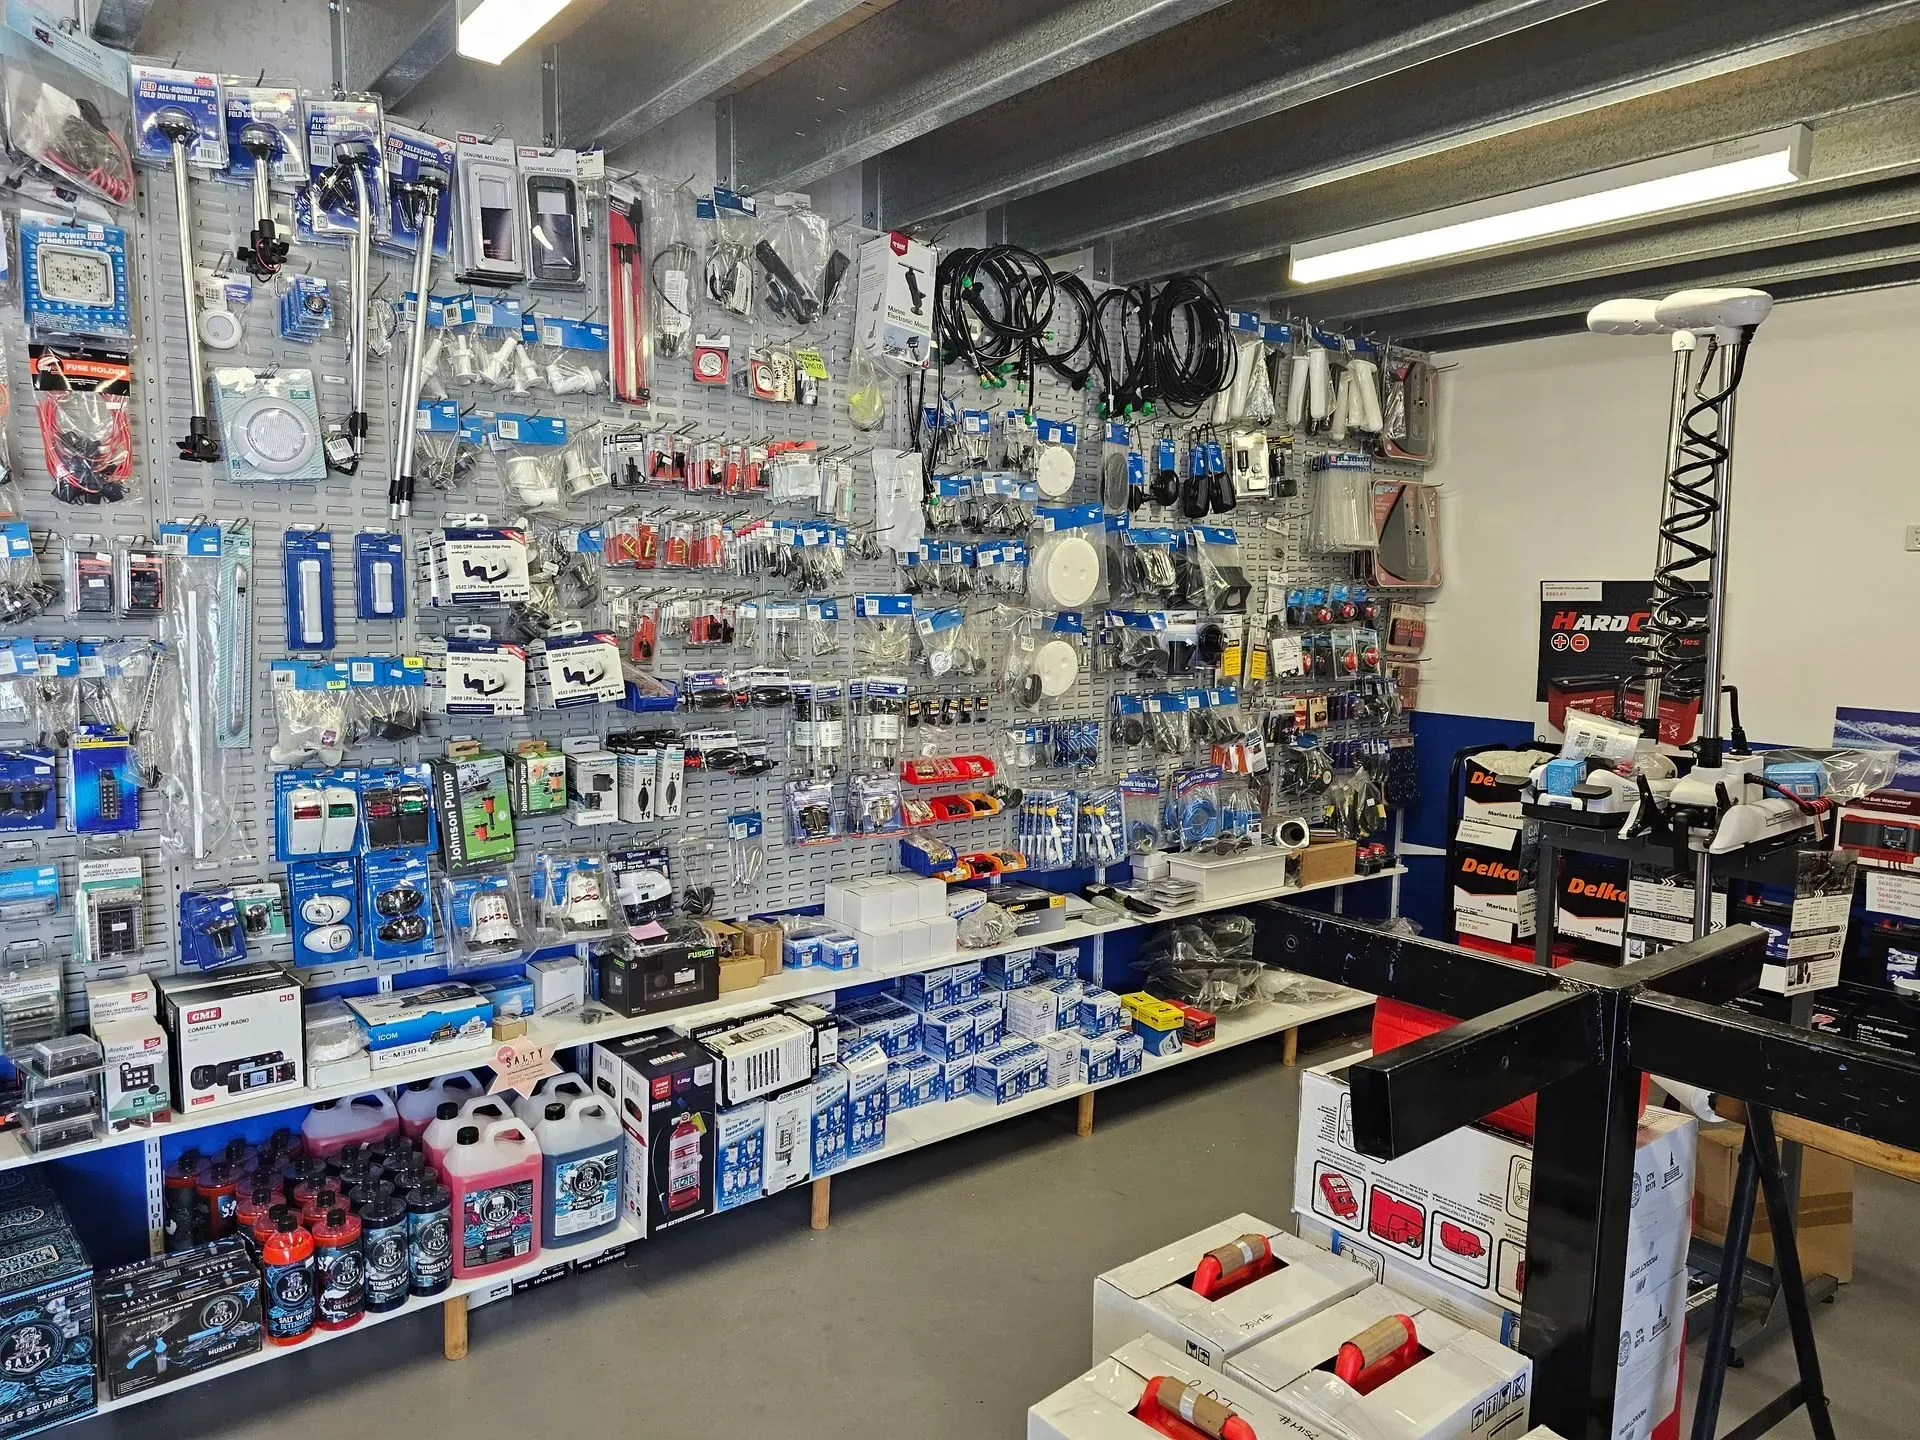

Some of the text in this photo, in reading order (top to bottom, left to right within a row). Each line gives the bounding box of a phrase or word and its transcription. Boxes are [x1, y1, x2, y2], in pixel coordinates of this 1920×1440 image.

[141, 82, 215, 96] LED ALL-ROUND LIGHTS
[177, 94, 200, 103] MOUNT
[389, 138, 438, 158] LED TELESCOPIC
[888, 305, 906, 315] Marine
[888, 312, 930, 330] Electronic Mount
[90, 366, 127, 376] HOLDER
[1625, 636, 1649, 644] AGM
[520, 784, 528, 812] Johnson
[443, 772, 462, 860] Johnson Pump
[1487, 810, 1507, 818] Marine
[1462, 858, 1519, 882] Delko
[1486, 902, 1508, 912] Marine
[1595, 926, 1619, 936] Marine
[688, 949, 715, 959] FUSION
[191, 1010, 217, 1021] GME
[188, 1024, 216, 1034] COMPACT
[231, 1018, 250, 1026] RADIO
[1857, 1024, 1908, 1038] Cyclic Applications:
[378, 1032, 398, 1041] ICOM
[506, 1047, 543, 1068] SALTY
[780, 1086, 811, 1100] 320R-RAC-01
[855, 1082, 870, 1091] Separating
[816, 1092, 826, 1100] Marine
[816, 1094, 830, 1104] Separating
[725, 1118, 749, 1132] Marine Water
[725, 1127, 744, 1137] Separating
[752, 1117, 760, 1125] Filter
[578, 1181, 597, 1190] SALTY
[488, 1209, 510, 1219] SALTY
[656, 1209, 705, 1231] FIRE EXTINGUISHER
[427, 1235, 449, 1249] SALTY
[486, 1231, 512, 1240] DETERGENT
[378, 1252, 400, 1266] SALTY
[418, 1262, 444, 1270] OUTBOARD
[110, 1260, 146, 1274] SALTY
[199, 1263, 234, 1276] SALTY
[336, 1268, 359, 1284] SALTY
[368, 1278, 395, 1286] OUTBOARD
[48, 1287, 73, 1298] CAPTAIN'S
[73, 1280, 92, 1290] MUSKET
[282, 1284, 308, 1300] SALTY
[122, 1293, 158, 1309] SALTY
[209, 1313, 232, 1324] SALTY
[278, 1310, 312, 1324] SALT WASH
[280, 1317, 312, 1330] DETERGENT
[208, 1343, 237, 1356] MUSKET
[5, 1346, 52, 1371] SALTY
[16, 1411, 25, 1419] &
[26, 1405, 40, 1415] SKI
[42, 1395, 69, 1410] WASH
